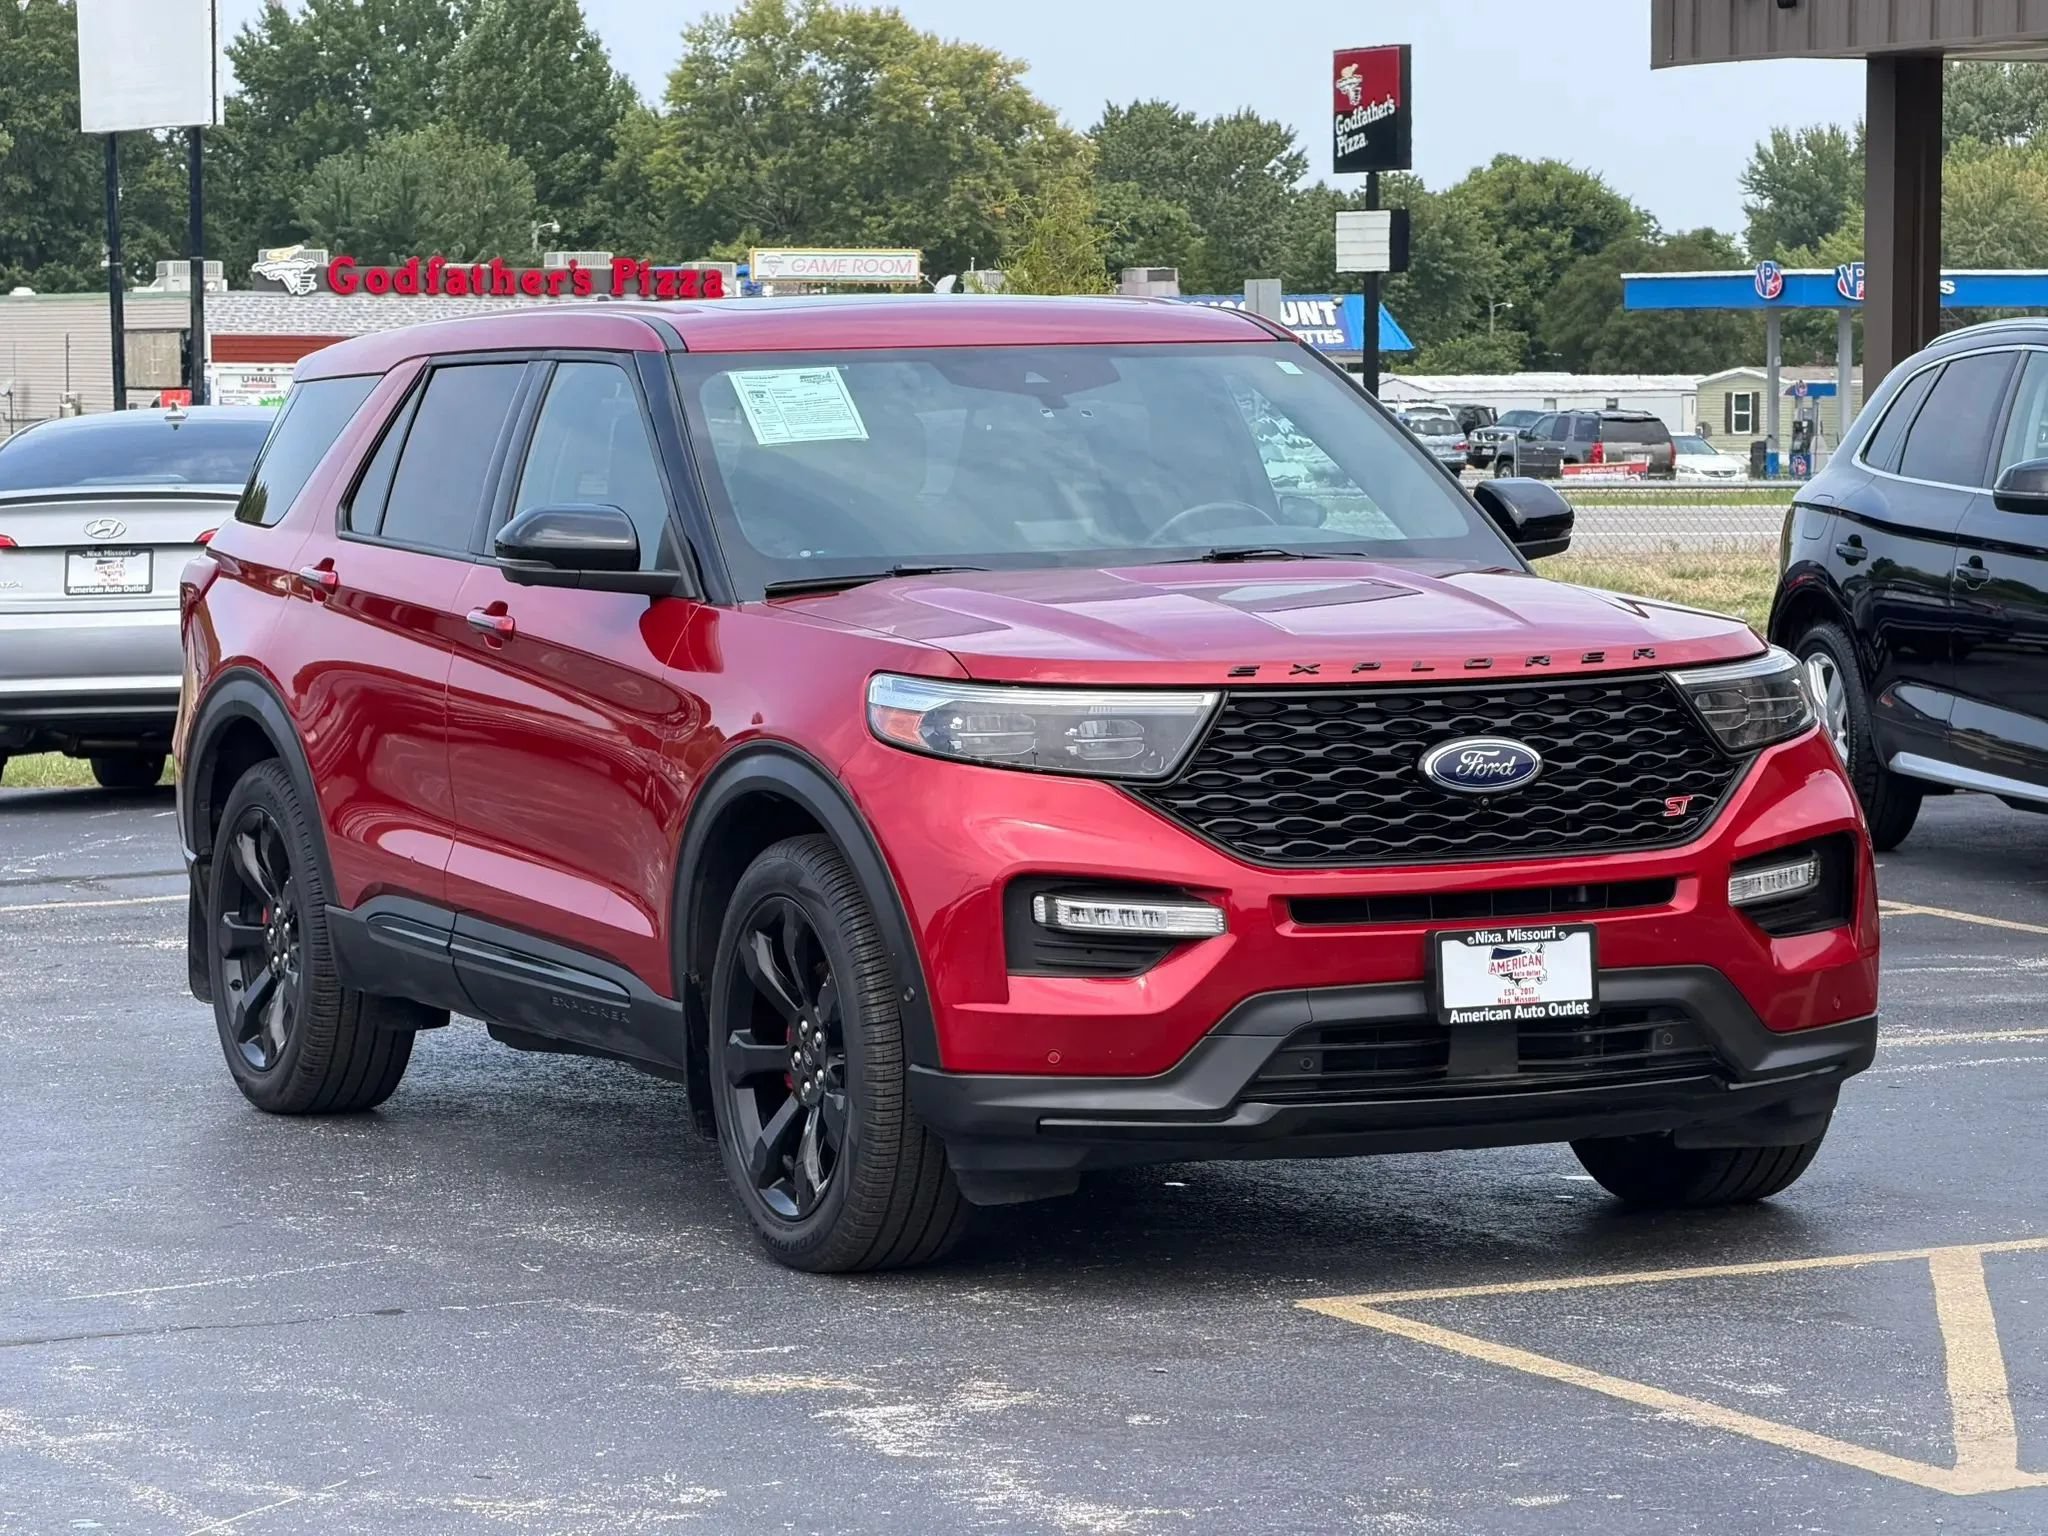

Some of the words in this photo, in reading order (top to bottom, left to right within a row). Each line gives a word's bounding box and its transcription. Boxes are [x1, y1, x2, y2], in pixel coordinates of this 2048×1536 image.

[1335, 93, 1396, 135] Godfather's
[1336, 132, 1367, 157] Pizza
[327, 255, 592, 297] Godfather's
[610, 256, 725, 299] Pizza
[791, 257, 848, 273] GAME
[852, 258, 912, 274] ROOM
[69, 586, 104, 594] American
[105, 585, 122, 593] Auto
[124, 584, 146, 592] Outlet
[1227, 647, 1656, 677] EXPLORER
[1456, 750, 1516, 780] Ford
[1664, 796, 1694, 817] ST
[1475, 930, 1505, 944] Nixa,
[1507, 926, 1556, 942] Missouri
[1490, 954, 1542, 974] AMERICAN
[1520, 987, 1535, 995] 2017
[552, 996, 630, 1023] EXPLORER
[1450, 1007, 1511, 1024] American
[1514, 1004, 1546, 1020] Auto
[1548, 1001, 1590, 1017] Outlet
